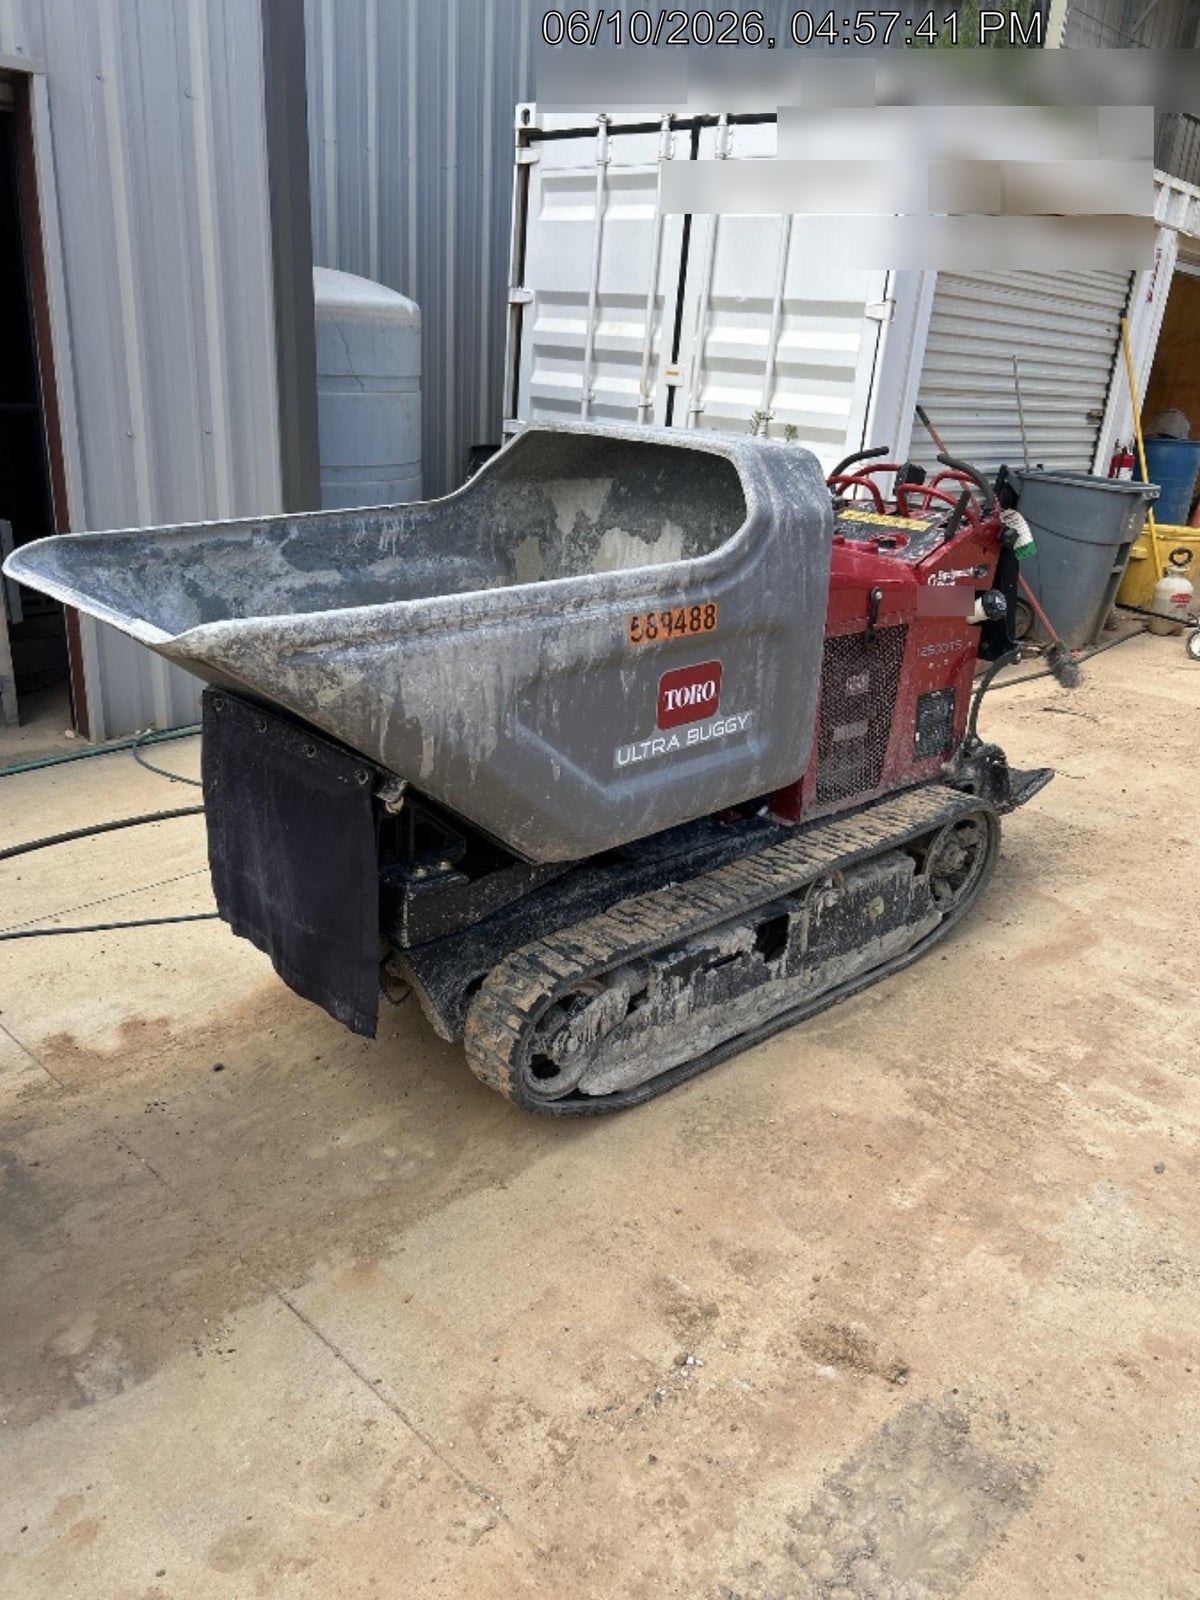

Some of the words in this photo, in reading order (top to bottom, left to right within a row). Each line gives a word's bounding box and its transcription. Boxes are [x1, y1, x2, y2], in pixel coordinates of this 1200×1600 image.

[665, 680, 716, 712] TORO
[617, 734, 680, 766] ULTRA
[686, 712, 750, 744] BUGGY
